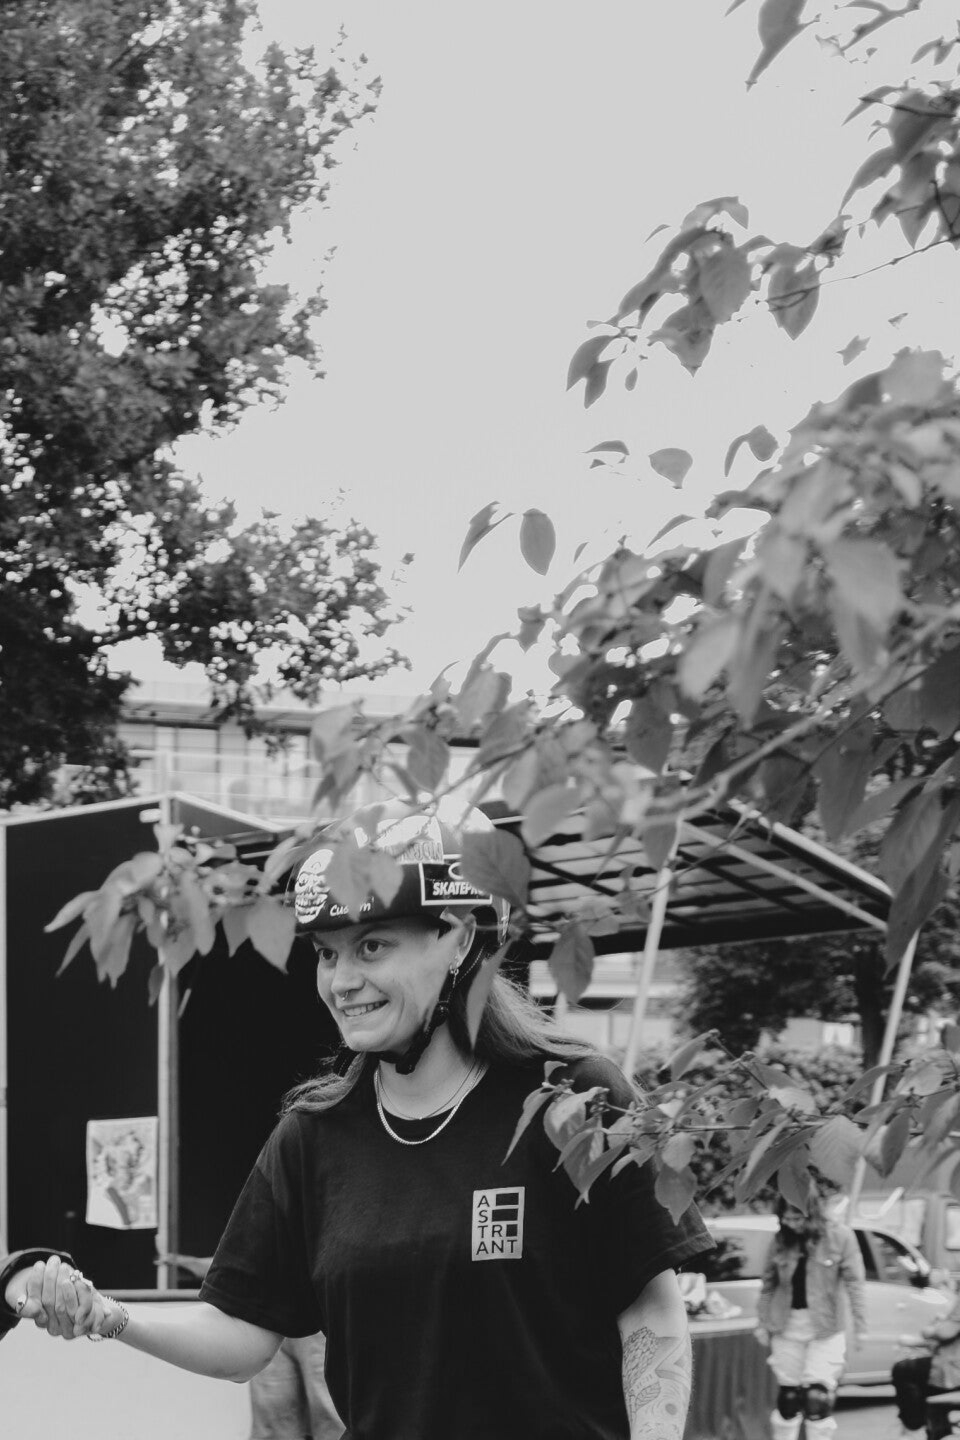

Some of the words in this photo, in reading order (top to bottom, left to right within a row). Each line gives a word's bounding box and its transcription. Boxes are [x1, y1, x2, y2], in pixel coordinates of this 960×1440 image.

[477, 1195, 490, 1208] A
[478, 1209, 488, 1223] S
[476, 1239, 518, 1256] ANT
